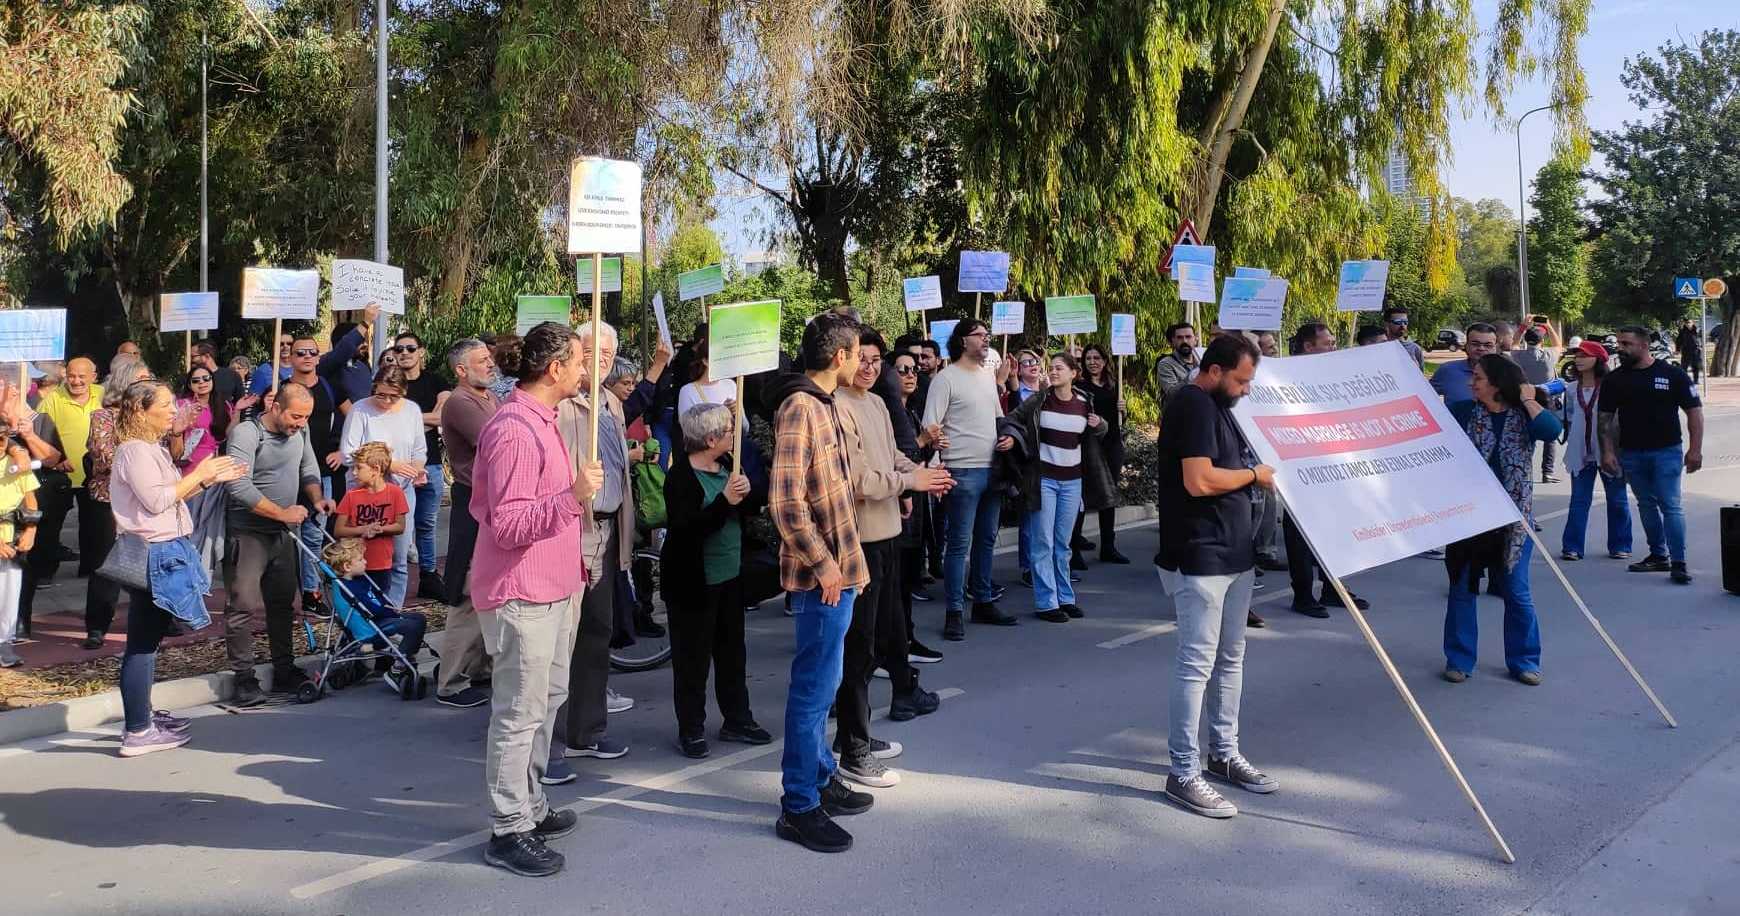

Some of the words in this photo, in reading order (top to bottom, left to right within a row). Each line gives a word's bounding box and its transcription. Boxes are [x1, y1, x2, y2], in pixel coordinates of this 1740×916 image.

[338, 263, 349, 278] I
[1301, 422, 1356, 444] MARRIAGE
[1360, 418, 1386, 440] NOT
[1391, 410, 1429, 433] CRIME
